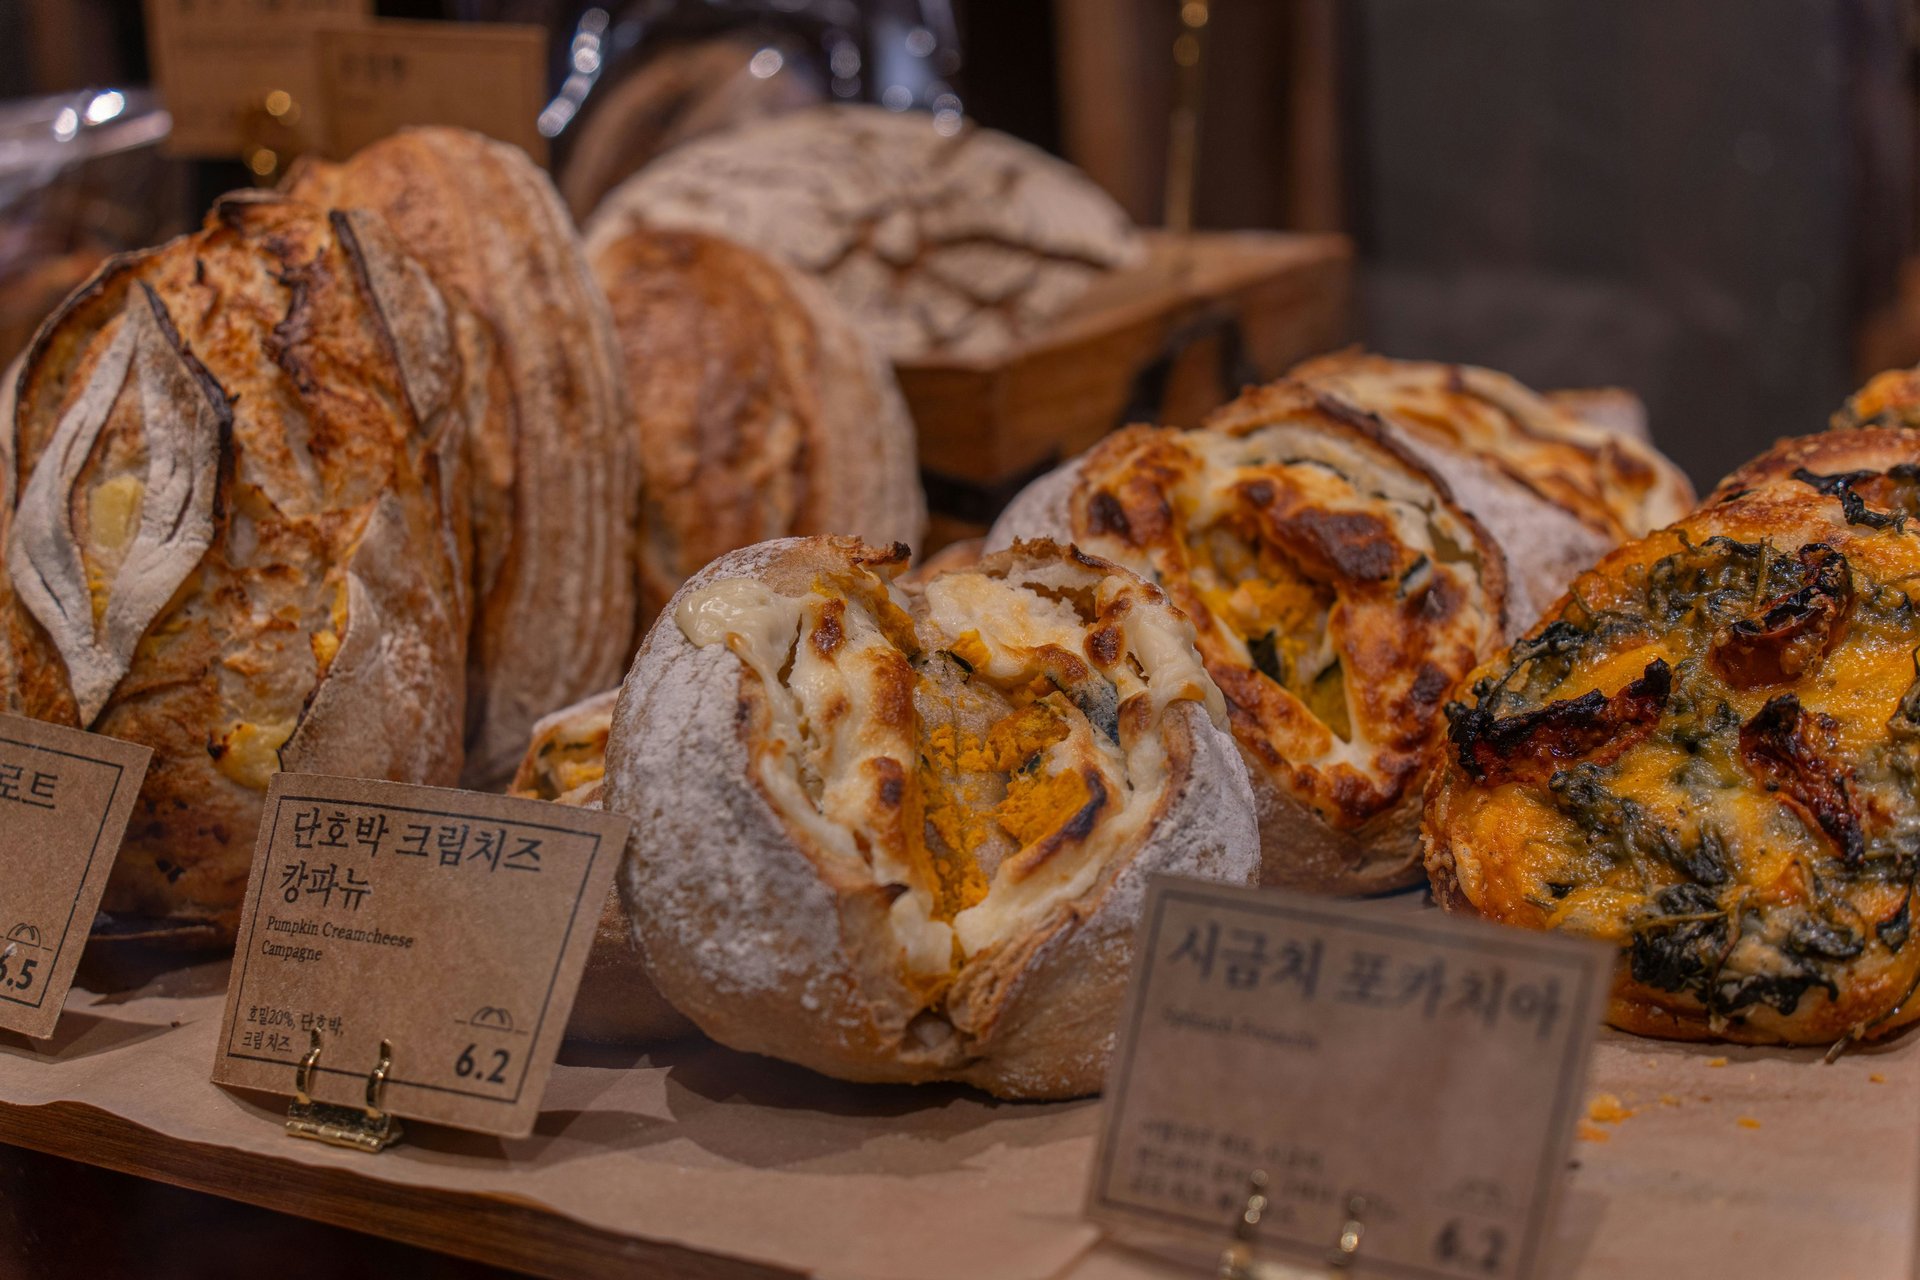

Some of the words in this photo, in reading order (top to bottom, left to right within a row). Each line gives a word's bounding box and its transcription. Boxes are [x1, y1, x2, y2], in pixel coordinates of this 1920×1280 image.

[294, 806, 390, 858] 단호박
[396, 823, 544, 873] 크림치즈
[279, 860, 373, 911] 캉파뉴
[261, 939, 323, 963] Campagne
[266, 915, 319, 937] Pumpkin
[322, 921, 414, 948] Creamcheese
[1166, 919, 1325, 1000] 시금치
[247, 1005, 295, 1030] 호밀20%,
[300, 1011, 344, 1037] 단호박,
[454, 1043, 511, 1085] 6.2
